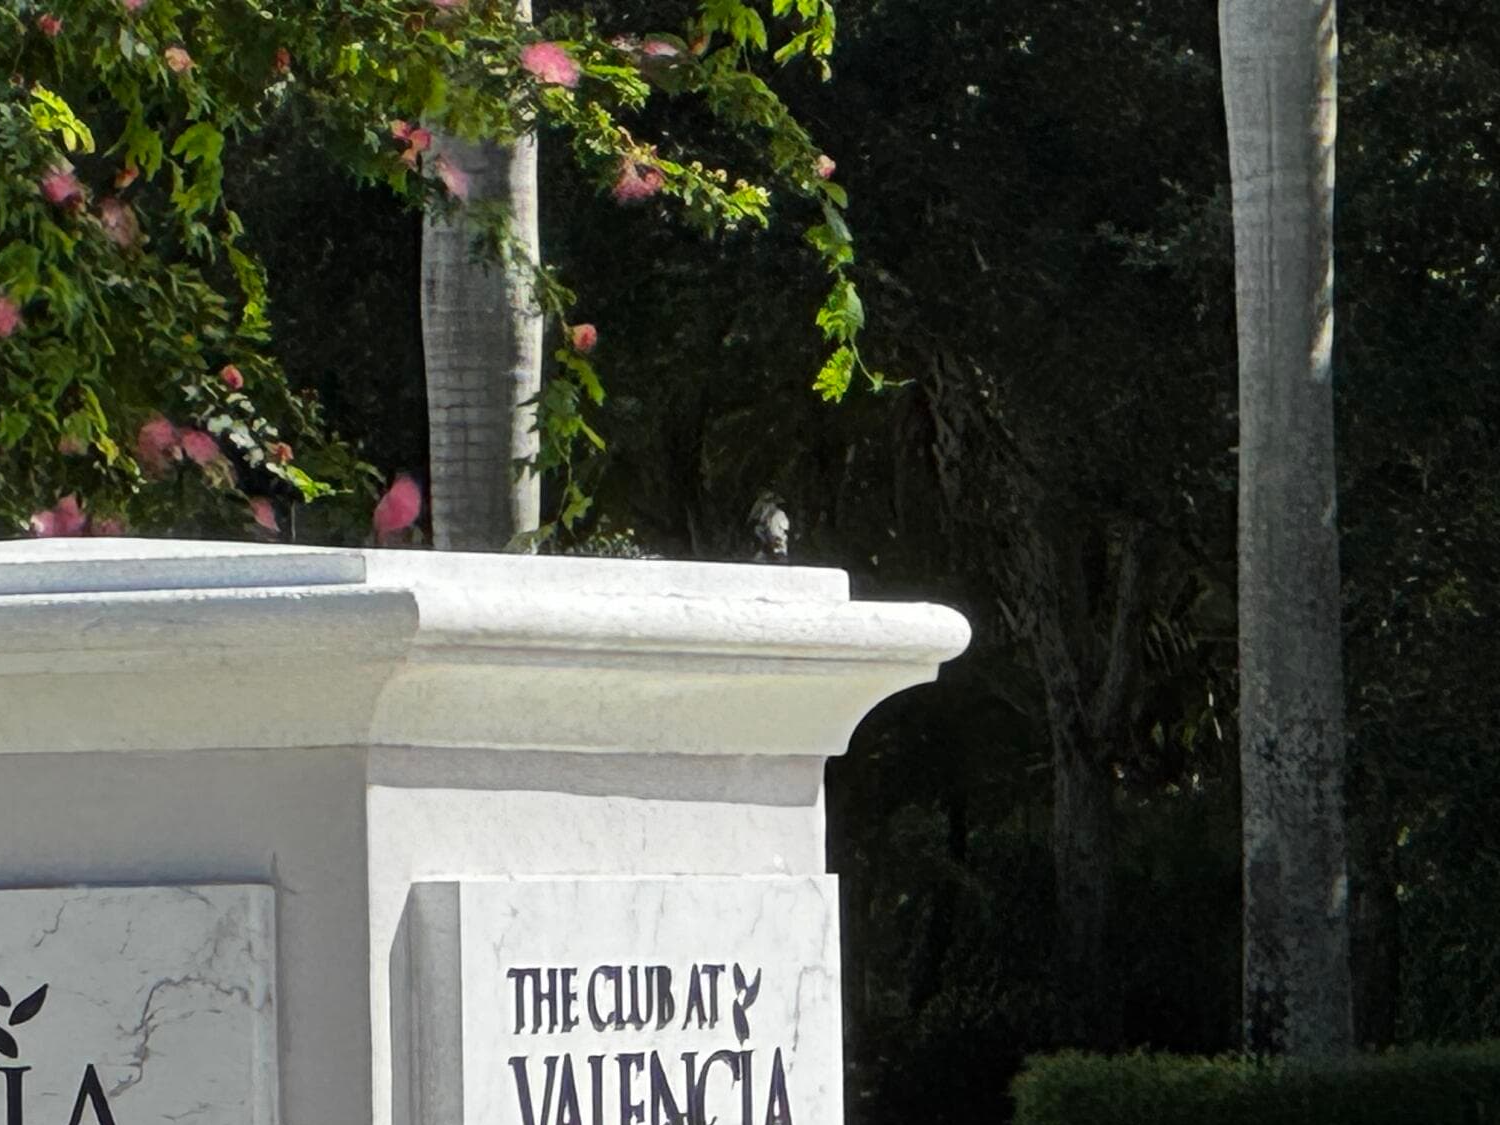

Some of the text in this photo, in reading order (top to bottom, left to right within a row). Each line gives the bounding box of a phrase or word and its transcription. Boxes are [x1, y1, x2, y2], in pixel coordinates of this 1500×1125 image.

[507, 963, 726, 1034] THE CLUB AT
